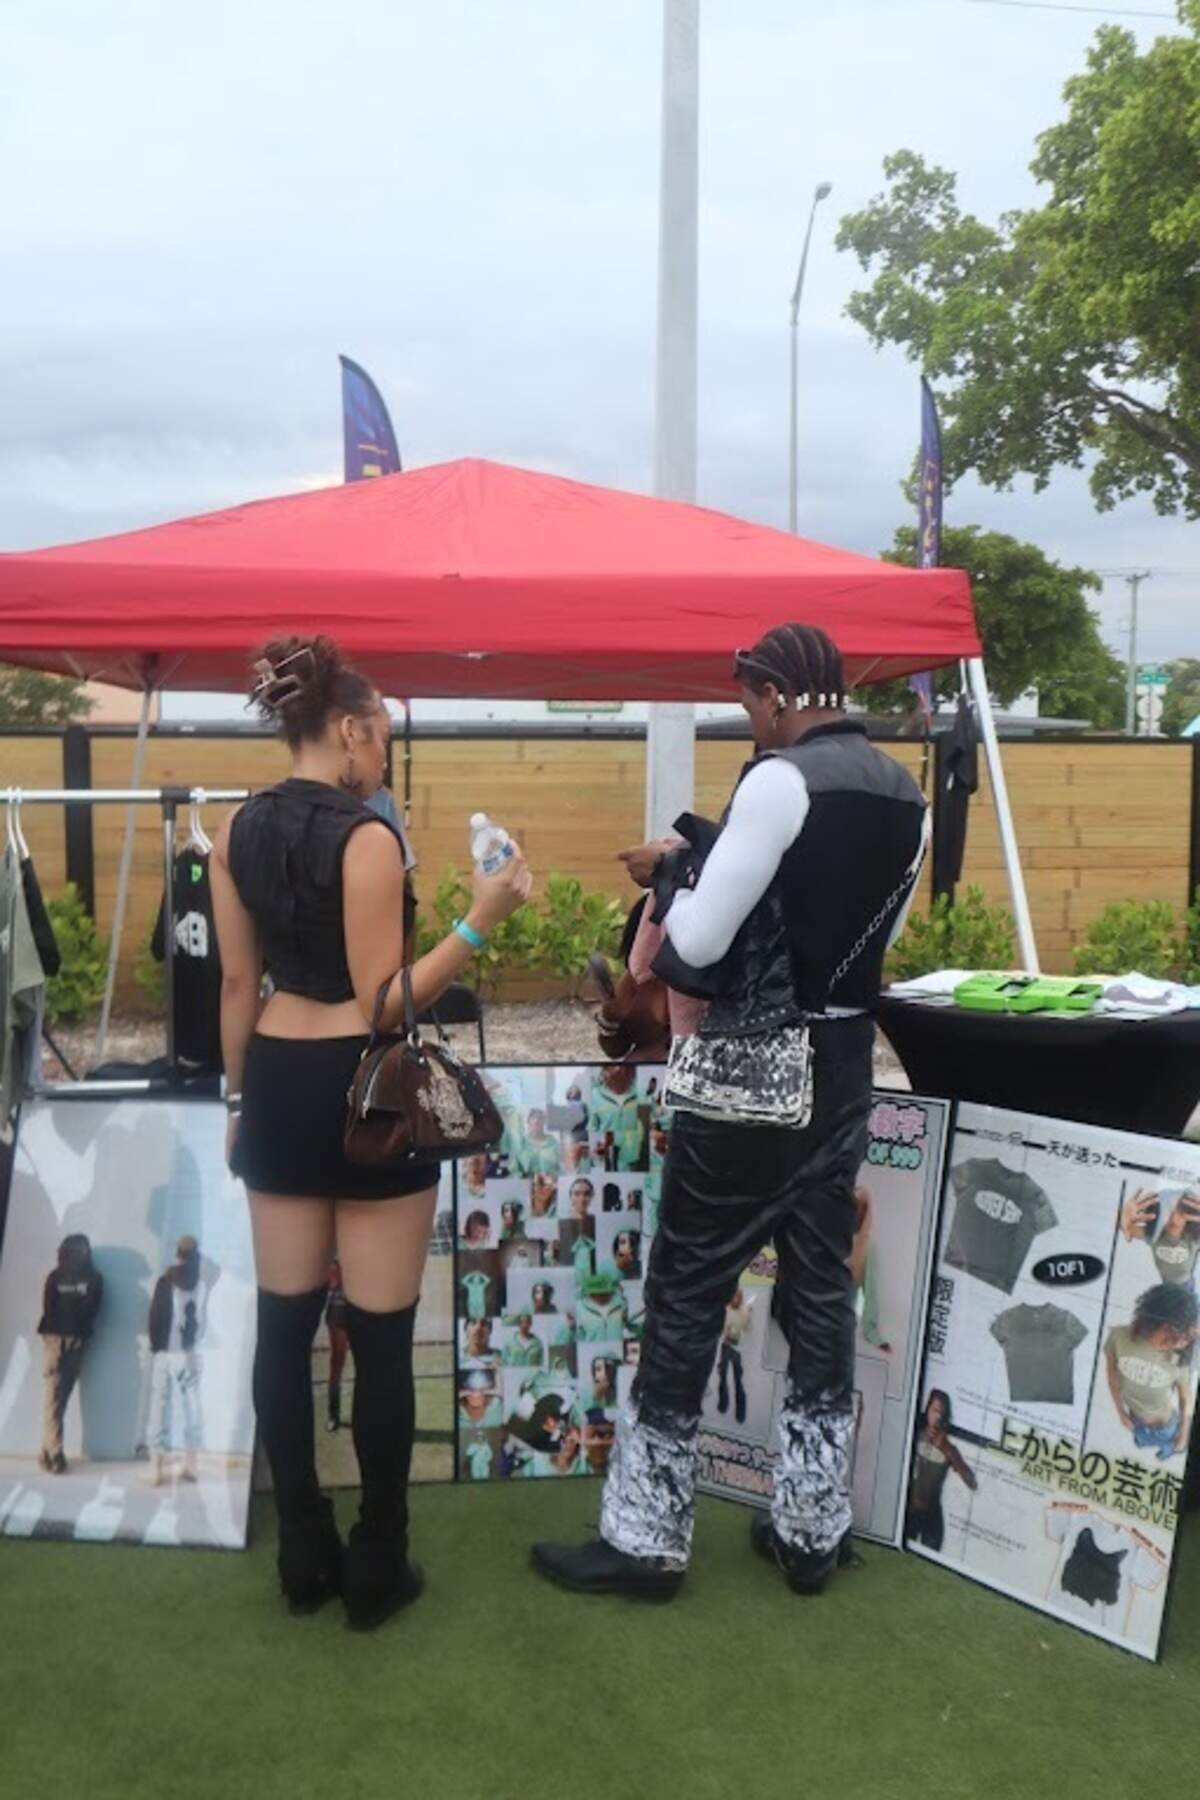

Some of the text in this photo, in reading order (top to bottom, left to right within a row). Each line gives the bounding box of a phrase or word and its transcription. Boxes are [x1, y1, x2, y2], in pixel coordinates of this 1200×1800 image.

[990, 1417, 1184, 1514] 上からの芸術
[1021, 1461, 1053, 1483] ART
[1058, 1476, 1108, 1506] FROM
[1112, 1498, 1177, 1532] ABOVE
